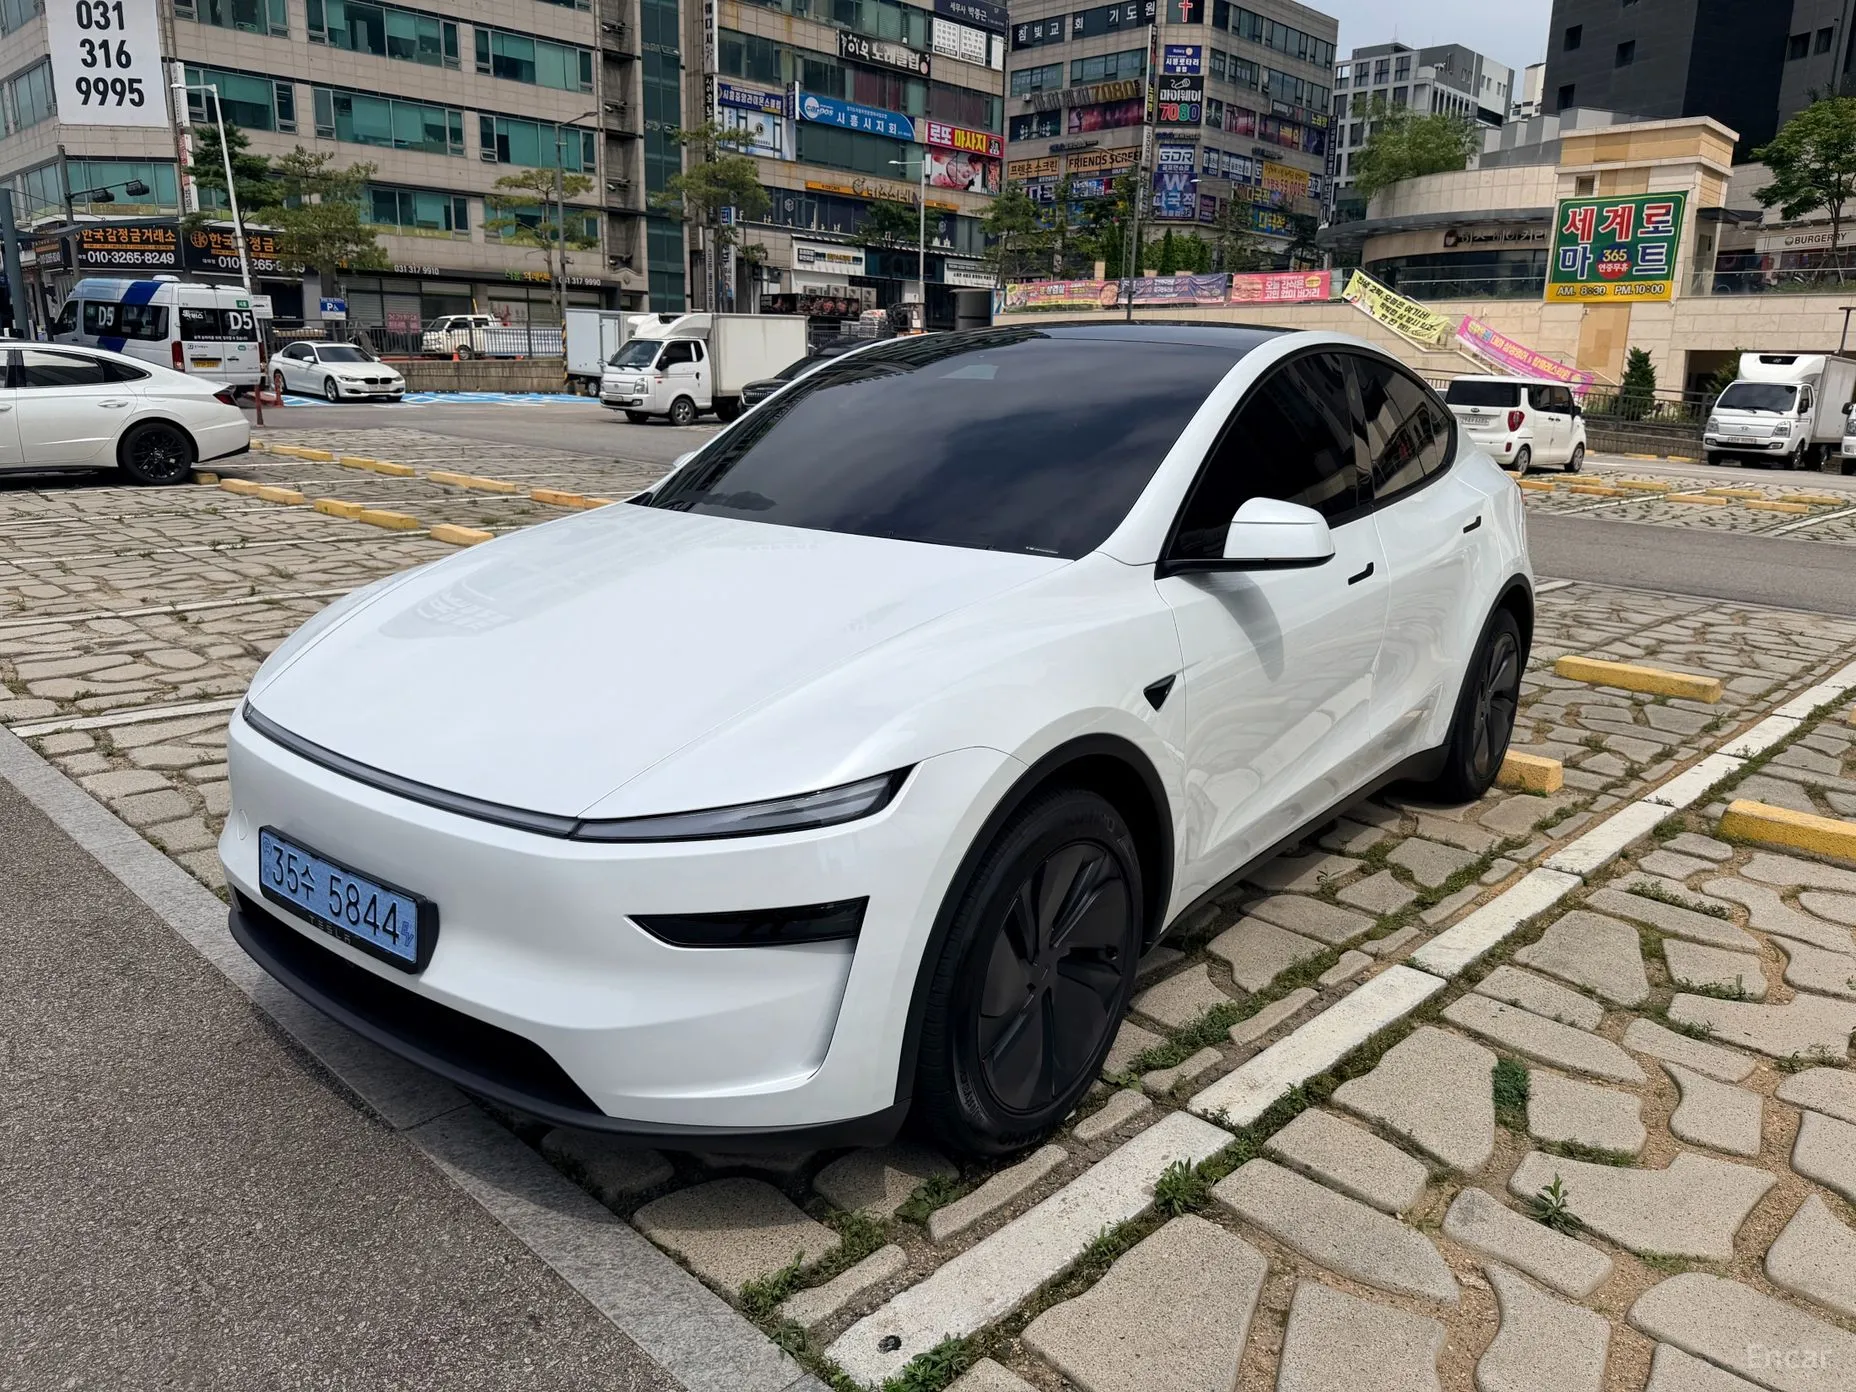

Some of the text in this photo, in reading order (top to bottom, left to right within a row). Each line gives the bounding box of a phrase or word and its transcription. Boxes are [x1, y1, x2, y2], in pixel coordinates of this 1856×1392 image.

[76, 0, 125, 30] 031
[1108, 1, 1156, 23] 기도원
[80, 38, 131, 68] 316
[872, 42, 921, 71] 노래클럽
[75, 76, 145, 107] 9995
[1089, 80, 1138, 104] 7080
[1160, 89, 1202, 102] 마이웨이
[1159, 103, 1201, 121] 7080
[837, 112, 897, 135] 시흥시지회
[930, 123, 952, 146] 로또
[954, 129, 987, 154] 마사지
[1068, 150, 1142, 169] FRIENDS SCREE
[1160, 151, 1194, 162] GDR
[1010, 159, 1058, 176] 프렌즈 스크린
[1163, 173, 1189, 191] W
[1563, 203, 1675, 244] 세계로
[82, 228, 177, 243] 한국감정금거래소
[1795, 232, 1847, 245] BURGERRY
[1602, 248, 1628, 262] 365
[1598, 263, 1630, 273] 연중무휴
[1264, 290, 1280, 299] 고민
[1281, 289, 1296, 299] 없이
[1265, 280, 1304, 290] 오늘 간식은
[1556, 284, 1665, 296] AM. 8:30 PM. 10:00
[327, 302, 334, 311] P
[1385, 295, 1406, 310] 오늘은
[1404, 305, 1431, 320] 여기서!
[99, 306, 115, 327] D5
[229, 312, 253, 330] D5
[272, 845, 400, 945] 35수 5844
[308, 915, 351, 944] TESLA
